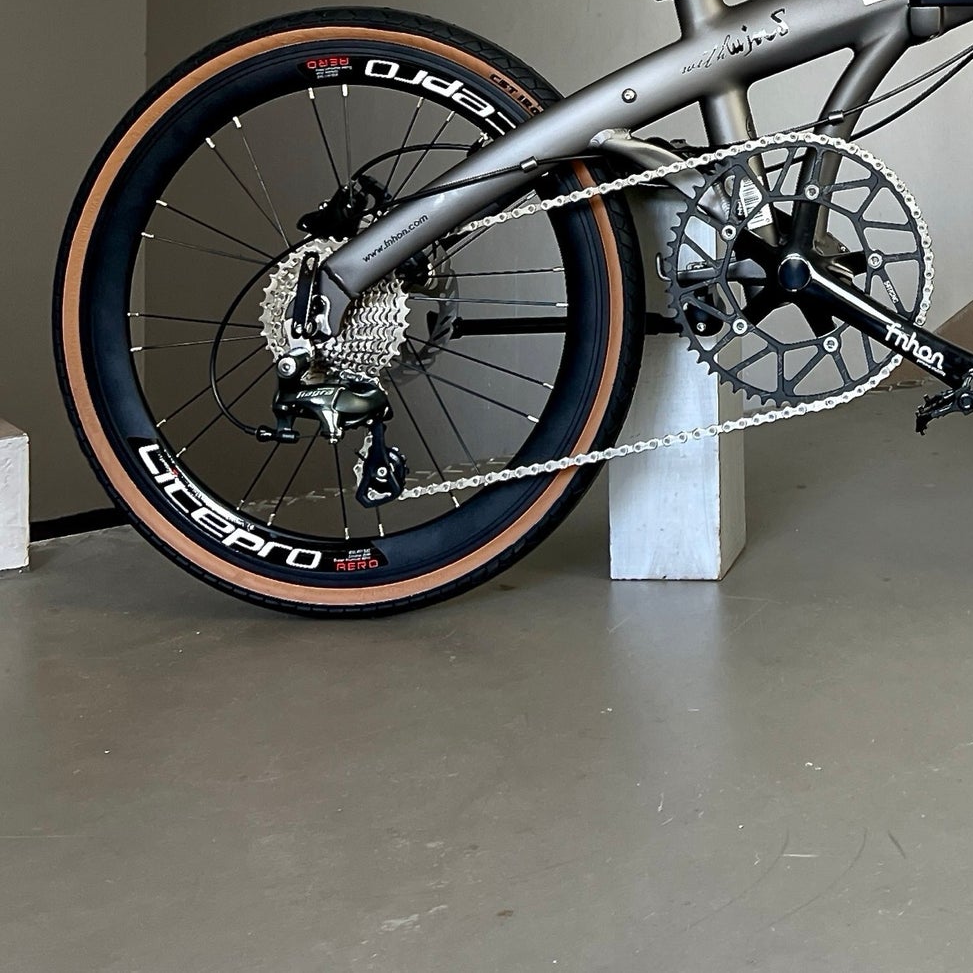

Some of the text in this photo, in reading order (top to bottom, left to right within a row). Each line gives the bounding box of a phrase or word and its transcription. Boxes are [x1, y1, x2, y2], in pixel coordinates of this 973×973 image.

[307, 57, 349, 69] AERO
[362, 214, 429, 262] www.fnhon.com
[884, 322, 944, 370] fnhon
[138, 443, 322, 570] Litepro
[336, 559, 378, 571] AERO
